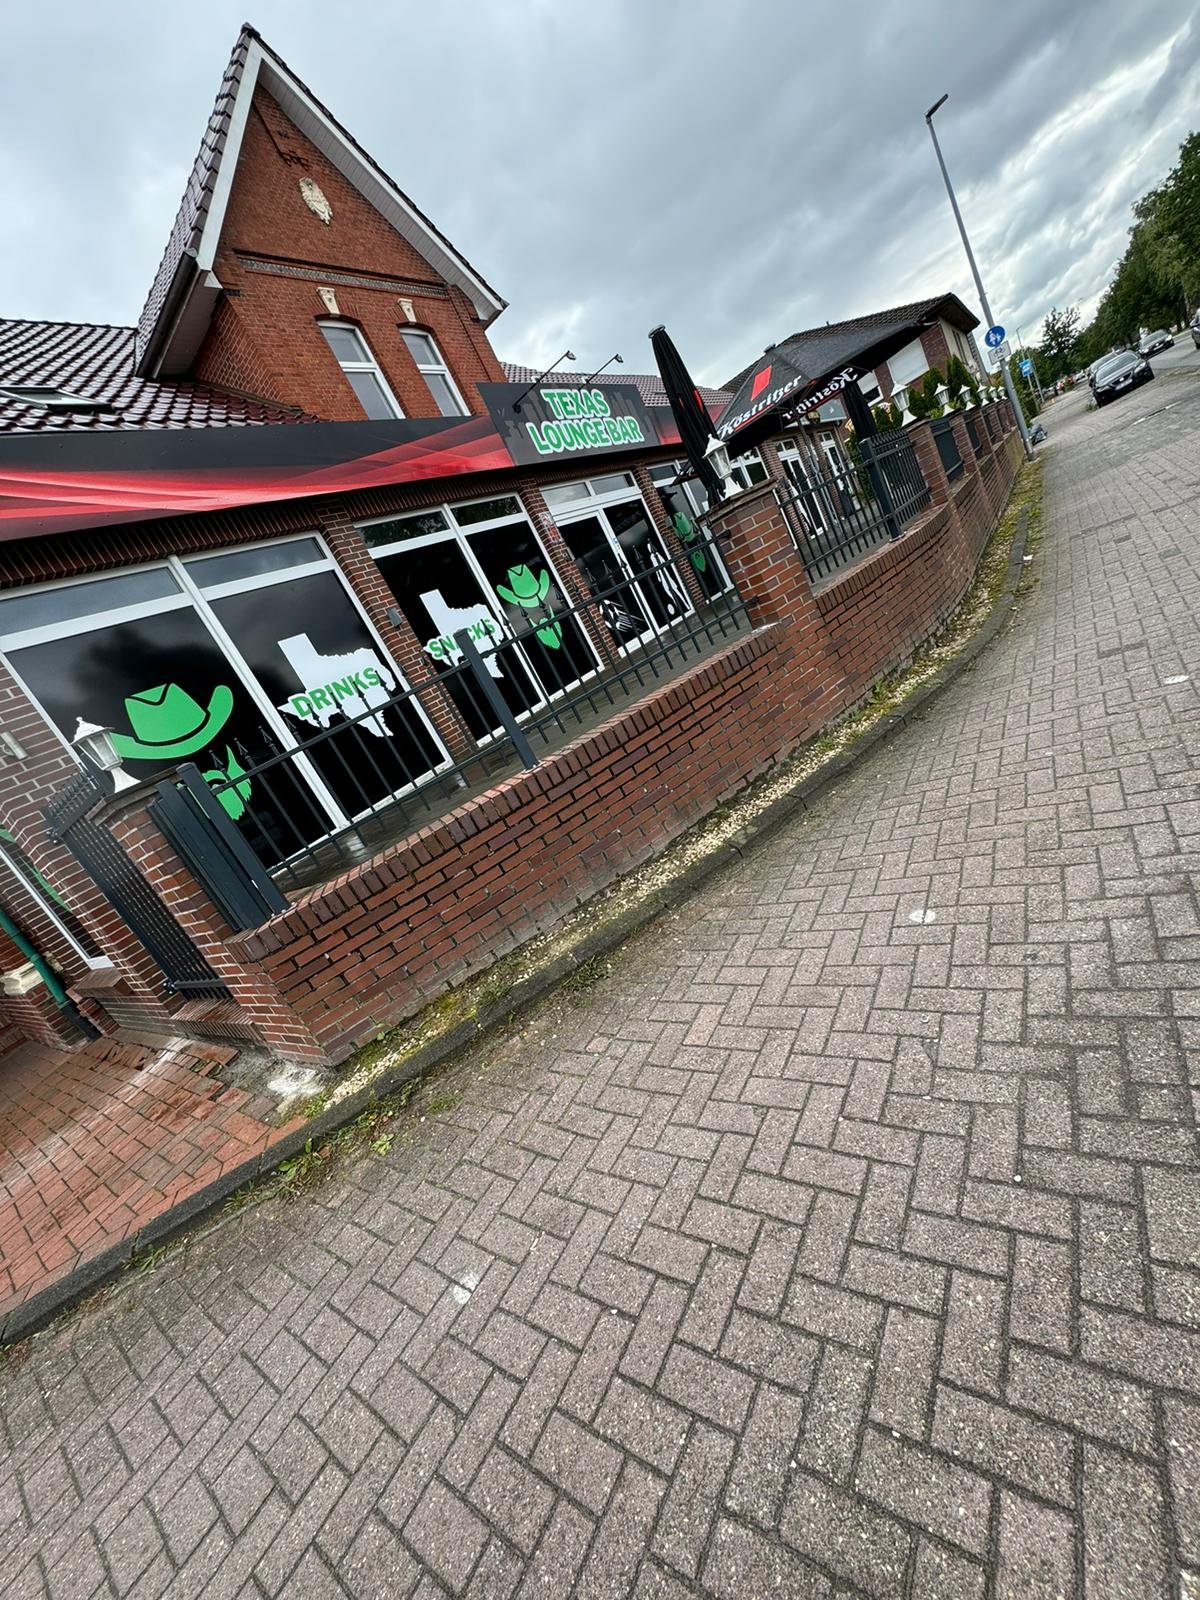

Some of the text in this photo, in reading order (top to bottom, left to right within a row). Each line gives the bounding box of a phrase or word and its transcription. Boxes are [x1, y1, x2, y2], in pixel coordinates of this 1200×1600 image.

[541, 388, 611, 418] TEXAS
[716, 375, 802, 440] Köstritzer
[526, 416, 645, 454] LOUNGE BAR
[427, 618, 496, 660] SNCKS
[290, 666, 381, 718] DRINKS
